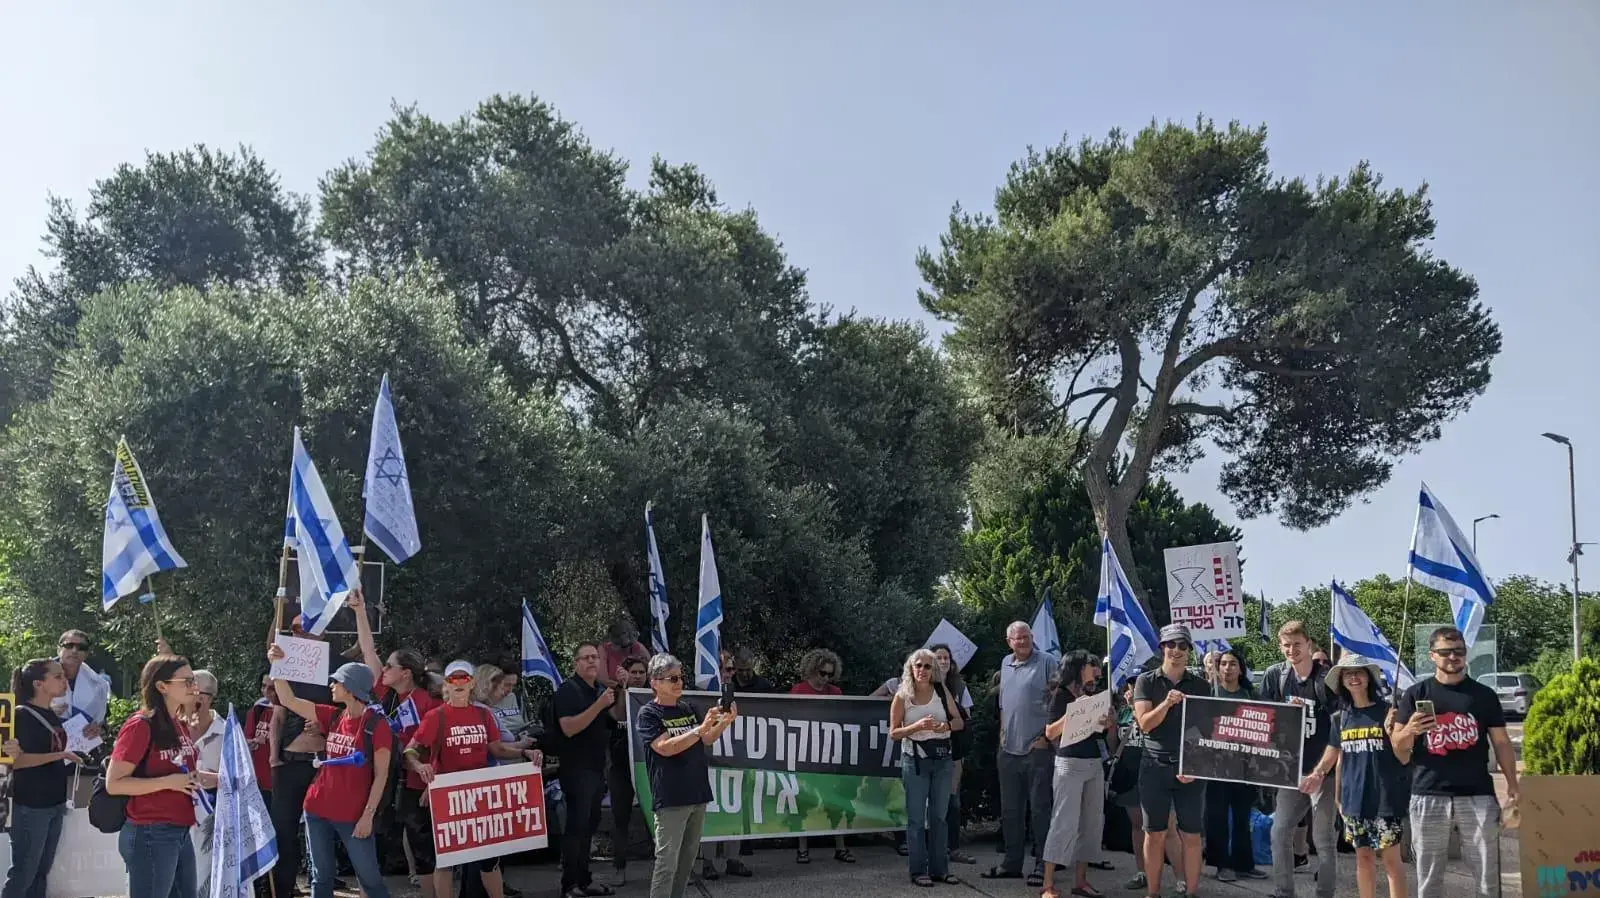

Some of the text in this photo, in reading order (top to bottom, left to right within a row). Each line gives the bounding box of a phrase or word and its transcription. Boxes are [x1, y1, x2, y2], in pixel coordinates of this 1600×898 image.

[1223, 616, 1244, 629] זה
[1219, 715, 1270, 732] הסטודנטיות
[1242, 709, 1268, 721] מחאת
[446, 734, 484, 747] דמוקרטיה
[870, 718, 901, 768] לי
[1218, 725, 1269, 742] והסטודנטים
[1198, 738, 1280, 759] נלחמים על הדמוקרטיה
[447, 780, 528, 816] אין בריאות
[753, 770, 799, 824] אין
[437, 806, 542, 848] בלי דמוקרטיה
